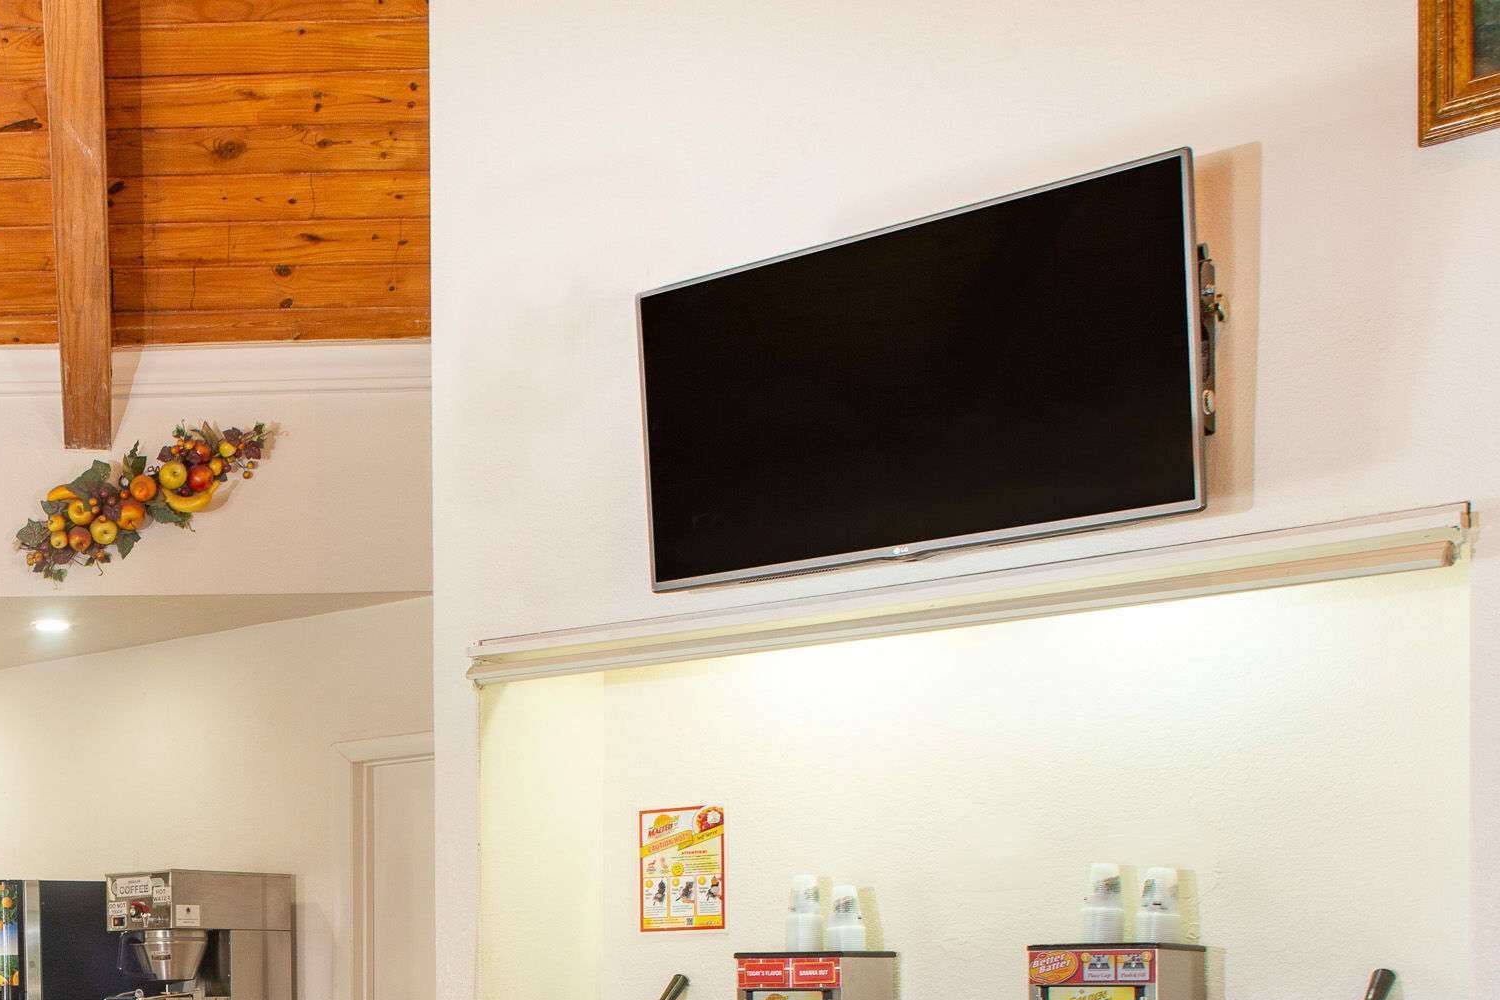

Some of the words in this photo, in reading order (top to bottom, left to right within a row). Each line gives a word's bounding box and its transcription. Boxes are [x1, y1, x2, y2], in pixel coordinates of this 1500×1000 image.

[119, 884, 149, 895] COFFEE
[1031, 954, 1066, 968] Better
[1038, 960, 1070, 973] Batter
